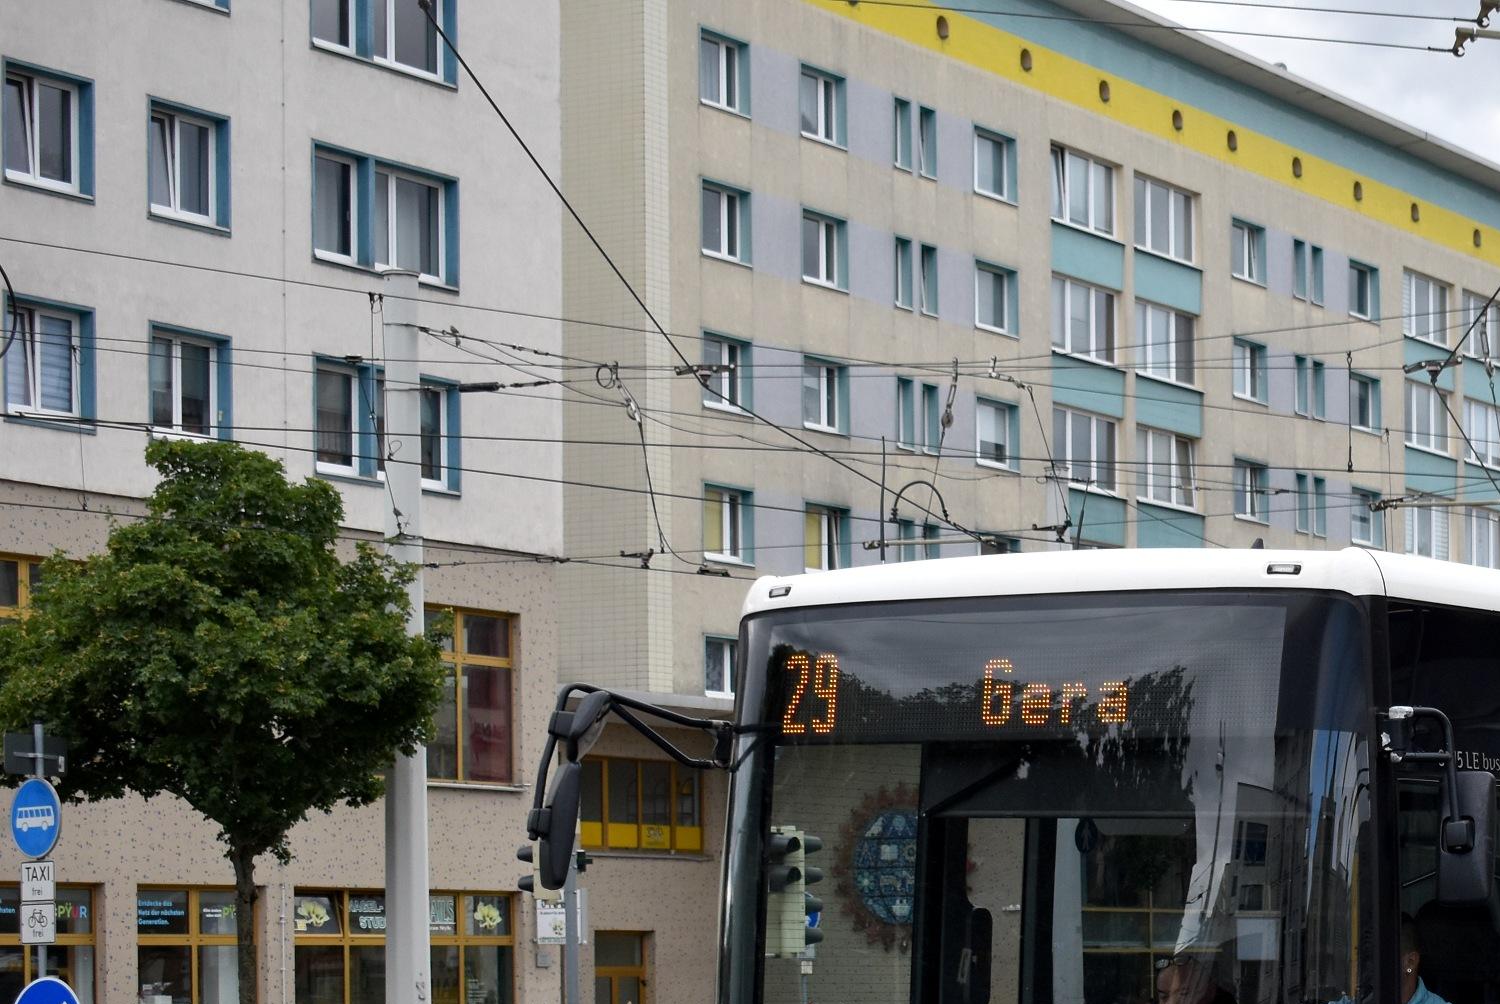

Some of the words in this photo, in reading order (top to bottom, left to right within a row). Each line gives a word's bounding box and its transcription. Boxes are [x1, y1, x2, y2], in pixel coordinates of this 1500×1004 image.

[781, 652, 838, 735] 29
[981, 657, 1130, 726] Gera
[1465, 751, 1480, 770] LE
[25, 866, 50, 881] TAXI
[32, 888, 43, 896] frei
[430, 900, 455, 922] AILS
[359, 915, 387, 929] STUD
[33, 930, 43, 938] frei
